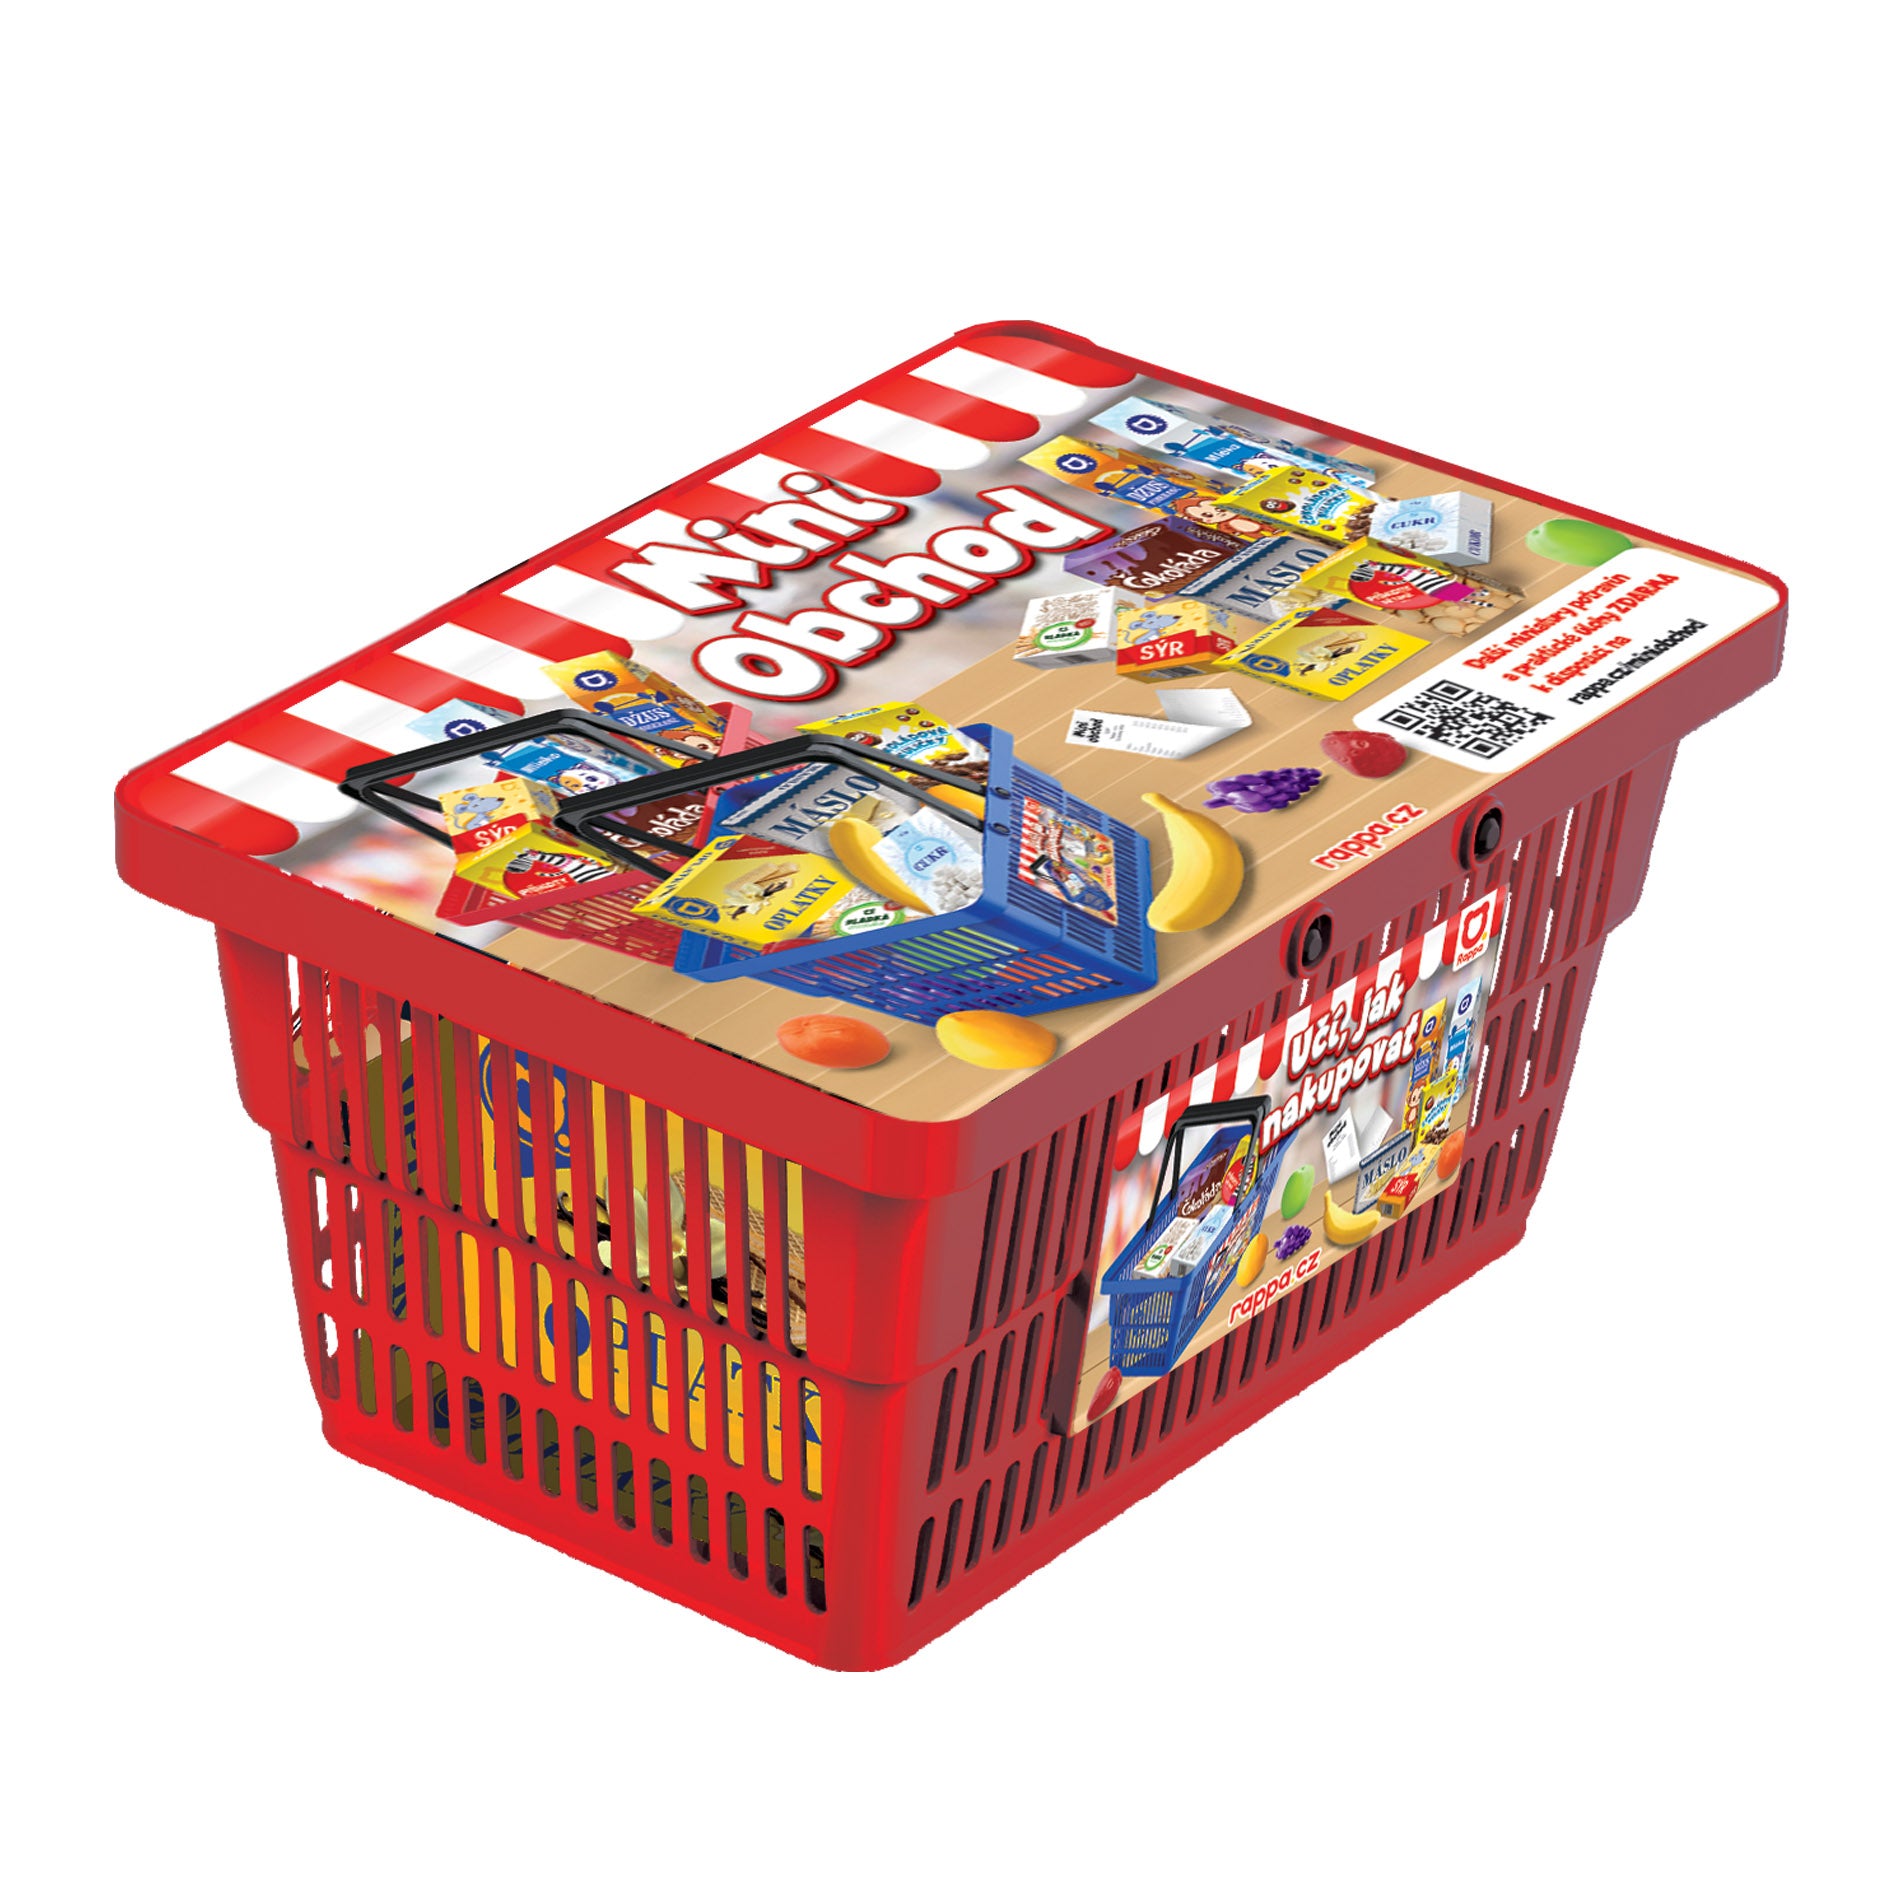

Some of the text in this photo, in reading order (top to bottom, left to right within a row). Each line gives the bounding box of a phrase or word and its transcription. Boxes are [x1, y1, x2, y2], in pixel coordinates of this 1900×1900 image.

[608, 470, 908, 615] Mini
[1113, 549, 1222, 589] Čokoláda
[1226, 548, 1329, 608] MÁSLO
[1140, 639, 1184, 660] SÝR
[1462, 573, 1631, 669] Další miniatury potravin
[1502, 672, 1520, 681] a
[1511, 632, 1583, 677] praktické
[1605, 573, 1680, 614] ZDARMA
[1328, 642, 1400, 687] OPLATKY
[1544, 644, 1614, 686] dispozici
[1605, 635, 1632, 649] na
[1567, 617, 1709, 705] rappa.cz/miniobchod
[618, 706, 671, 728] DŽUS
[769, 774, 881, 840] MÁSLO
[1312, 803, 1427, 870] rappa.cz
[912, 845, 949, 872] CUKR
[763, 874, 839, 932] OPLATKY
[1456, 943, 1484, 966] Rappa
[1350, 970, 1406, 1048] jak
[1260, 1010, 1422, 1154] nakupovat
[1361, 1147, 1408, 1189] MÁSLO
[1229, 1248, 1321, 1326] rappa.cz
